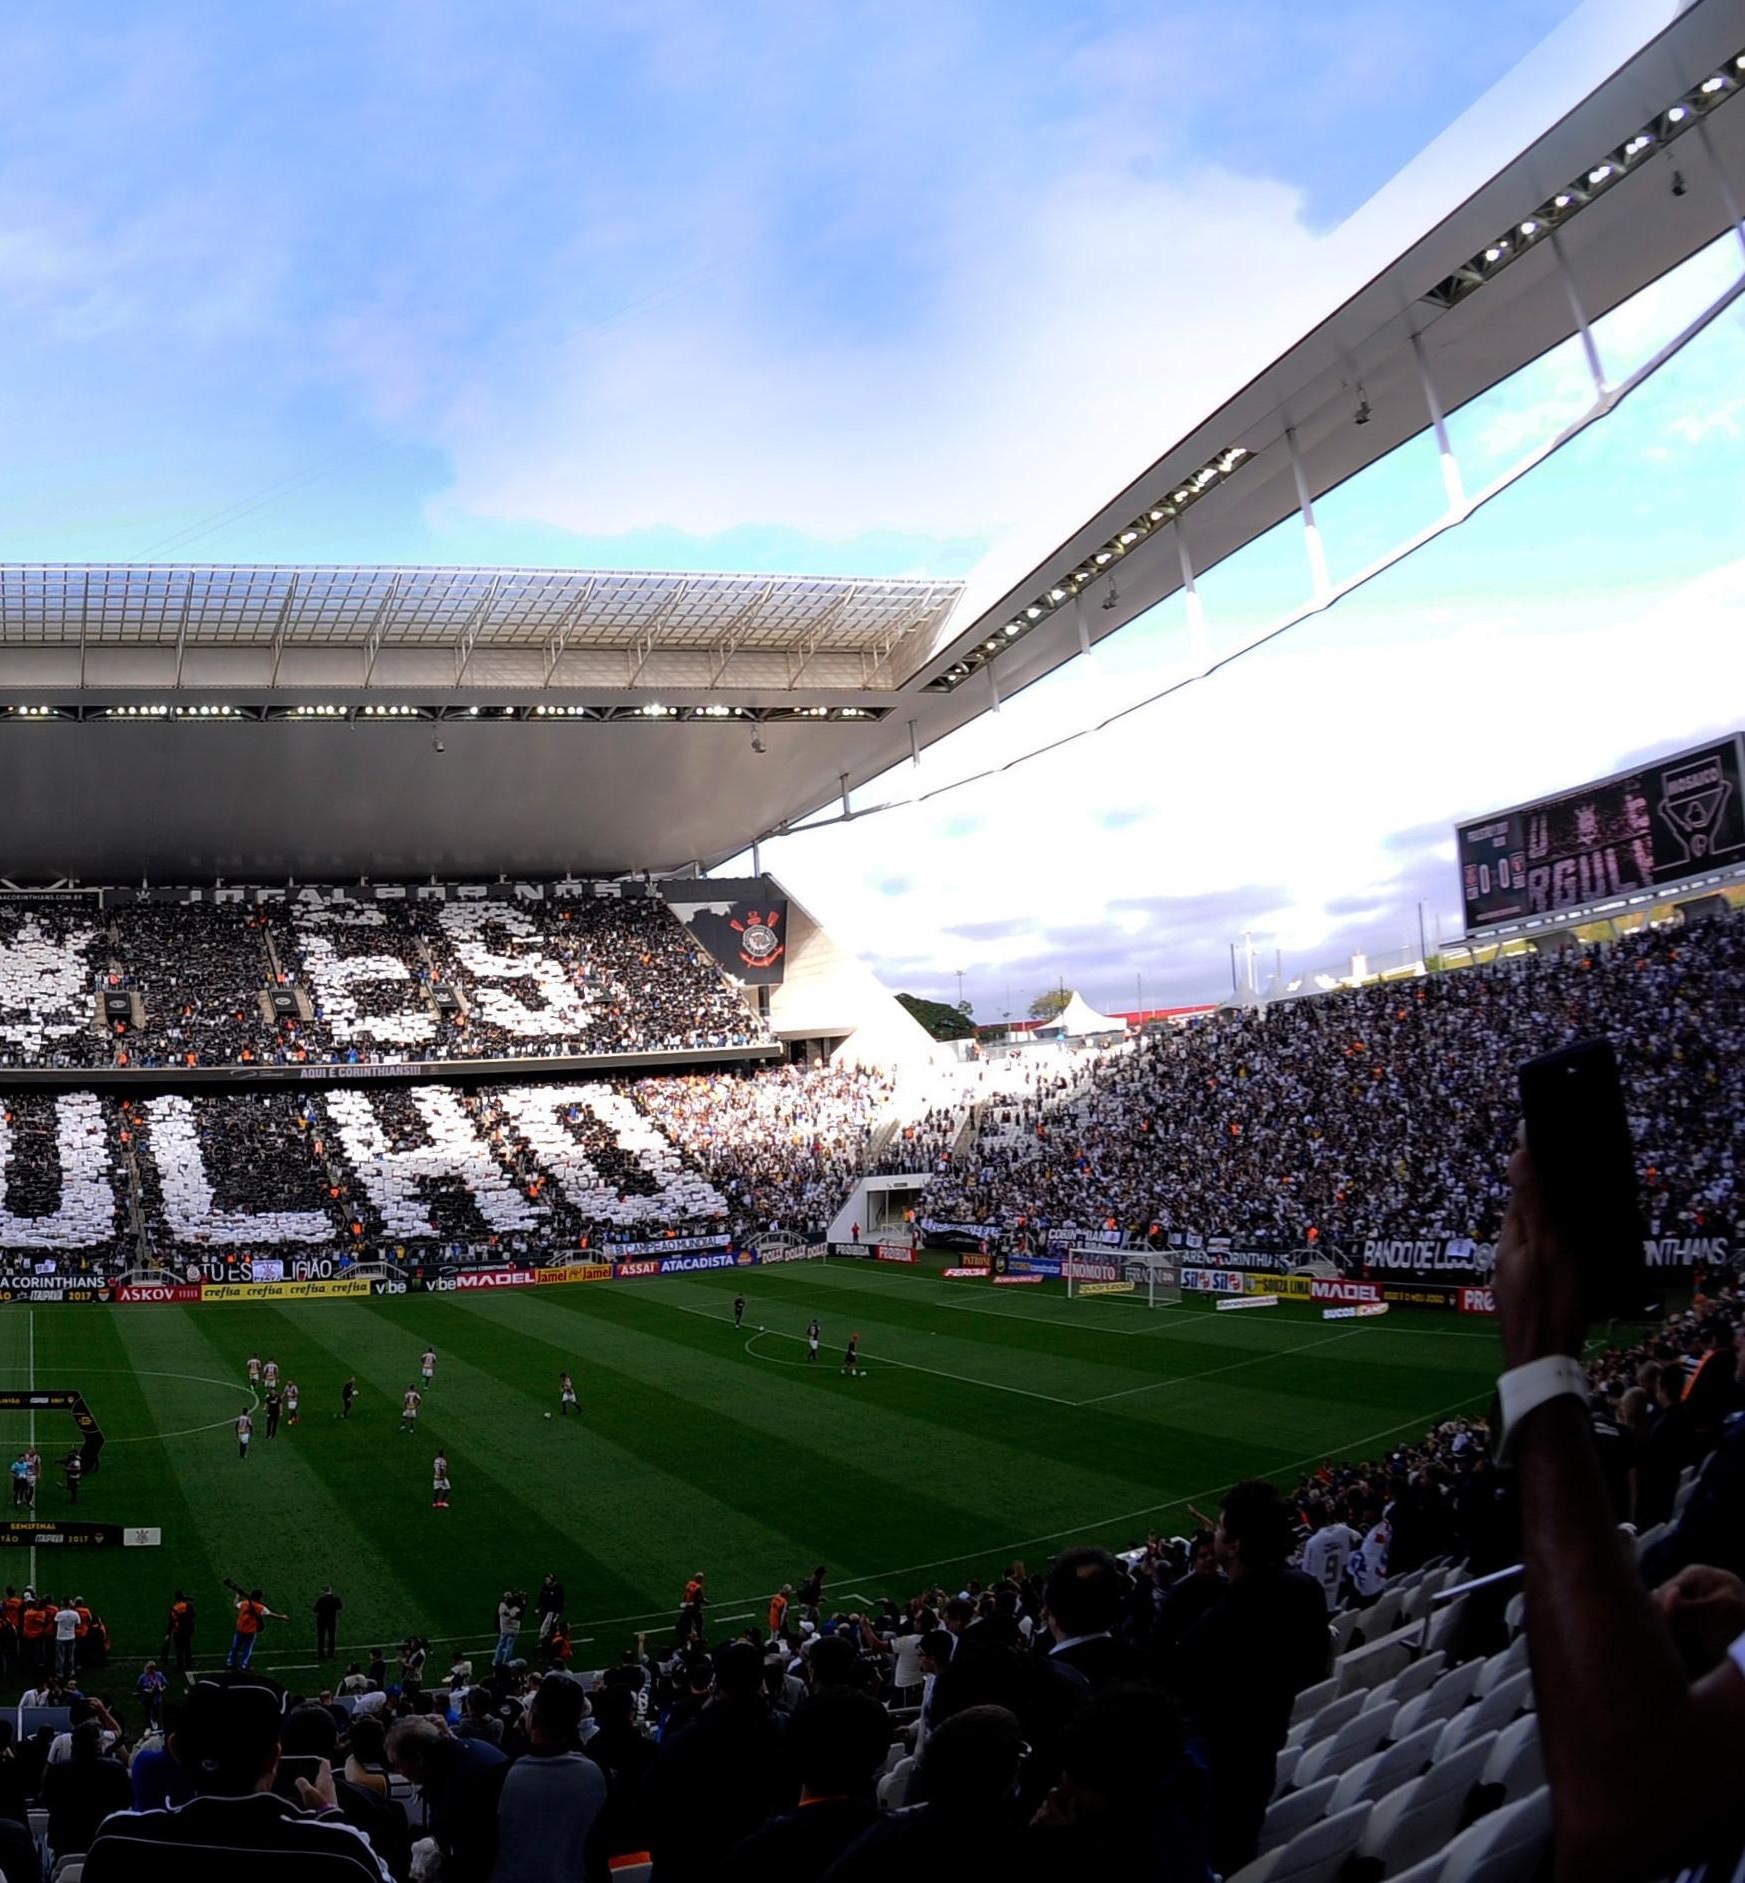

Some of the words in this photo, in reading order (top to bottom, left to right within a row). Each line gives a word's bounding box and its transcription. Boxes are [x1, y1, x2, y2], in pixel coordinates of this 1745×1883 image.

[1479, 863, 1491, 895] 0
[1498, 857, 1510, 889] 0
[300, 1068, 327, 1079] AQUI
[661, 1256, 734, 1273] ATACADISTA
[12, 1276, 106, 1288] CORINTHIANS
[1183, 1271, 1198, 1287] Sil
[1212, 1273, 1228, 1290] Sil
[205, 1286, 241, 1297] crefisa
[247, 1285, 282, 1297] crefisa
[290, 1283, 326, 1295] crefisa
[331, 1281, 367, 1293] crefisa
[67, 1290, 93, 1301] 2017
[120, 1288, 175, 1301] ASKOV
[9, 1522, 57, 1531] SEMIFINAL
[68, 1535, 90, 1544] 2017
